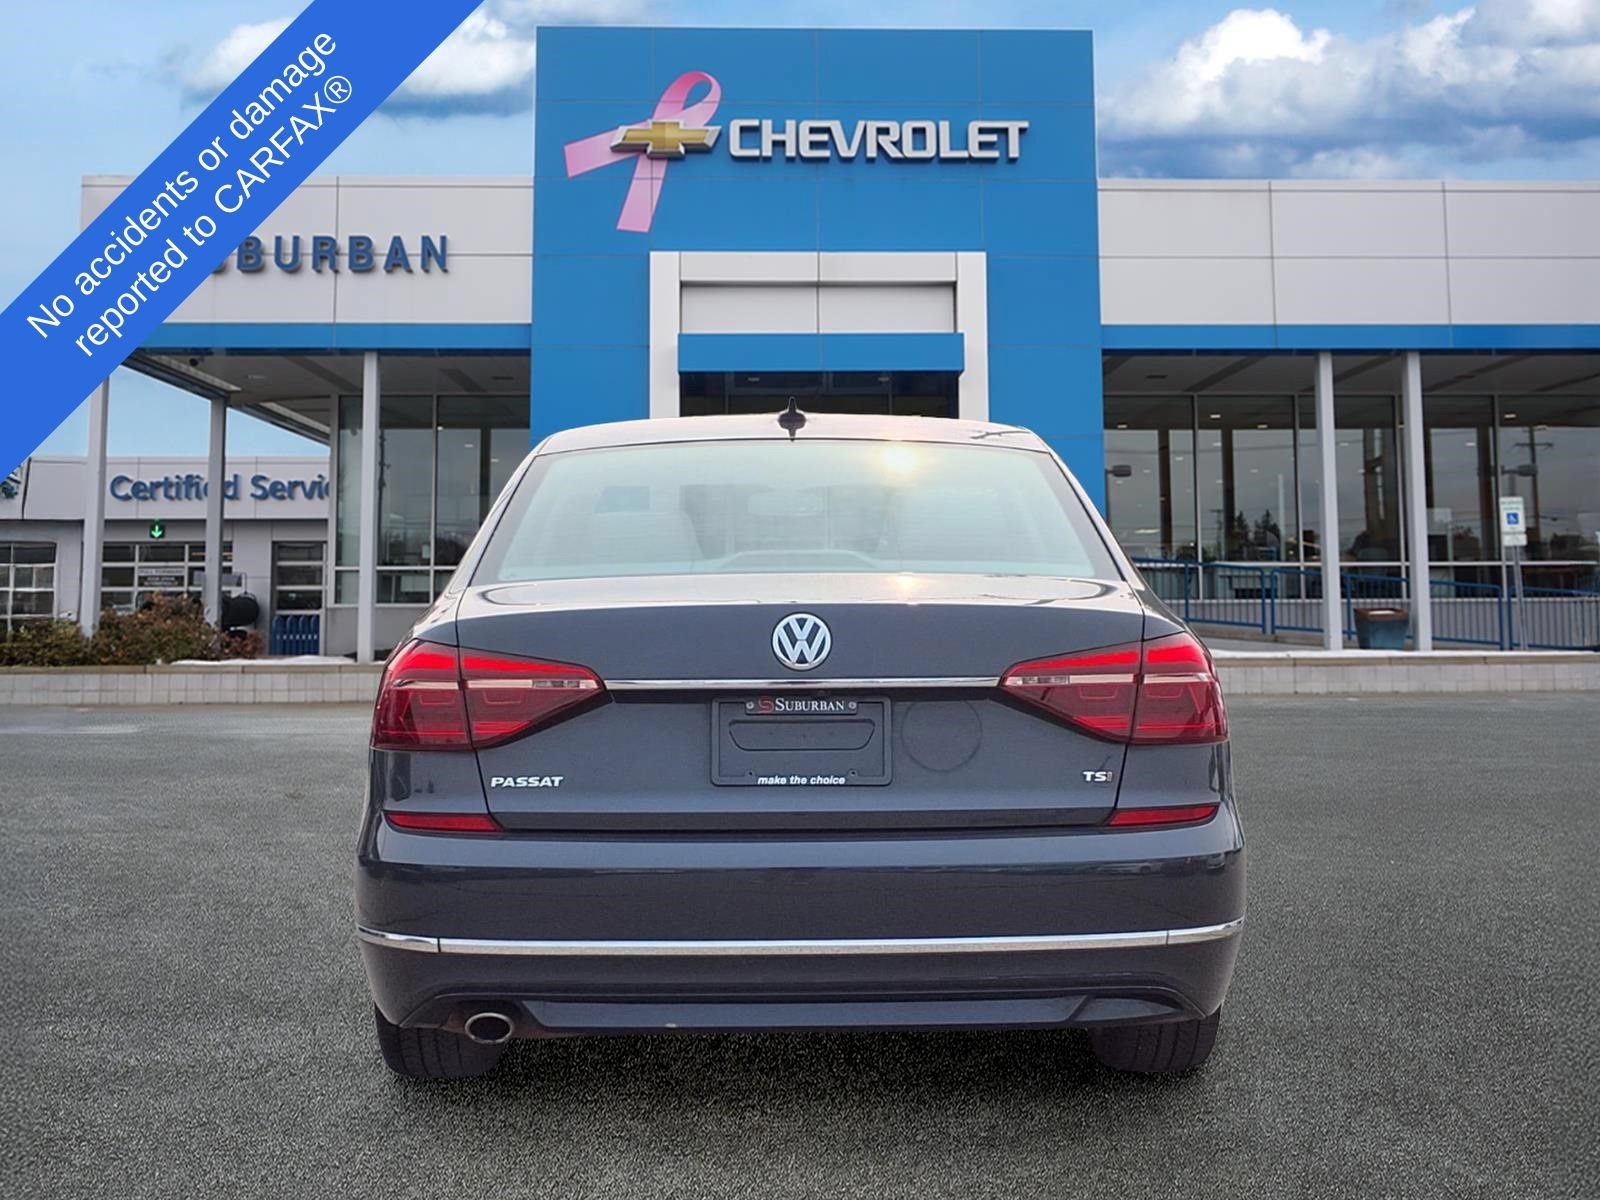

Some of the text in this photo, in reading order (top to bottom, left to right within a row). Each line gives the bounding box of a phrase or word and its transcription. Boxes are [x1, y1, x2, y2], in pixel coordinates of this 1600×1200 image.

[729, 119, 1029, 160] CHEVROLET
[212, 235, 449, 274] BURBAN
[110, 474, 240, 501] Certifid
[490, 776, 564, 788] PASSAT
[757, 775, 846, 785] make the choice
